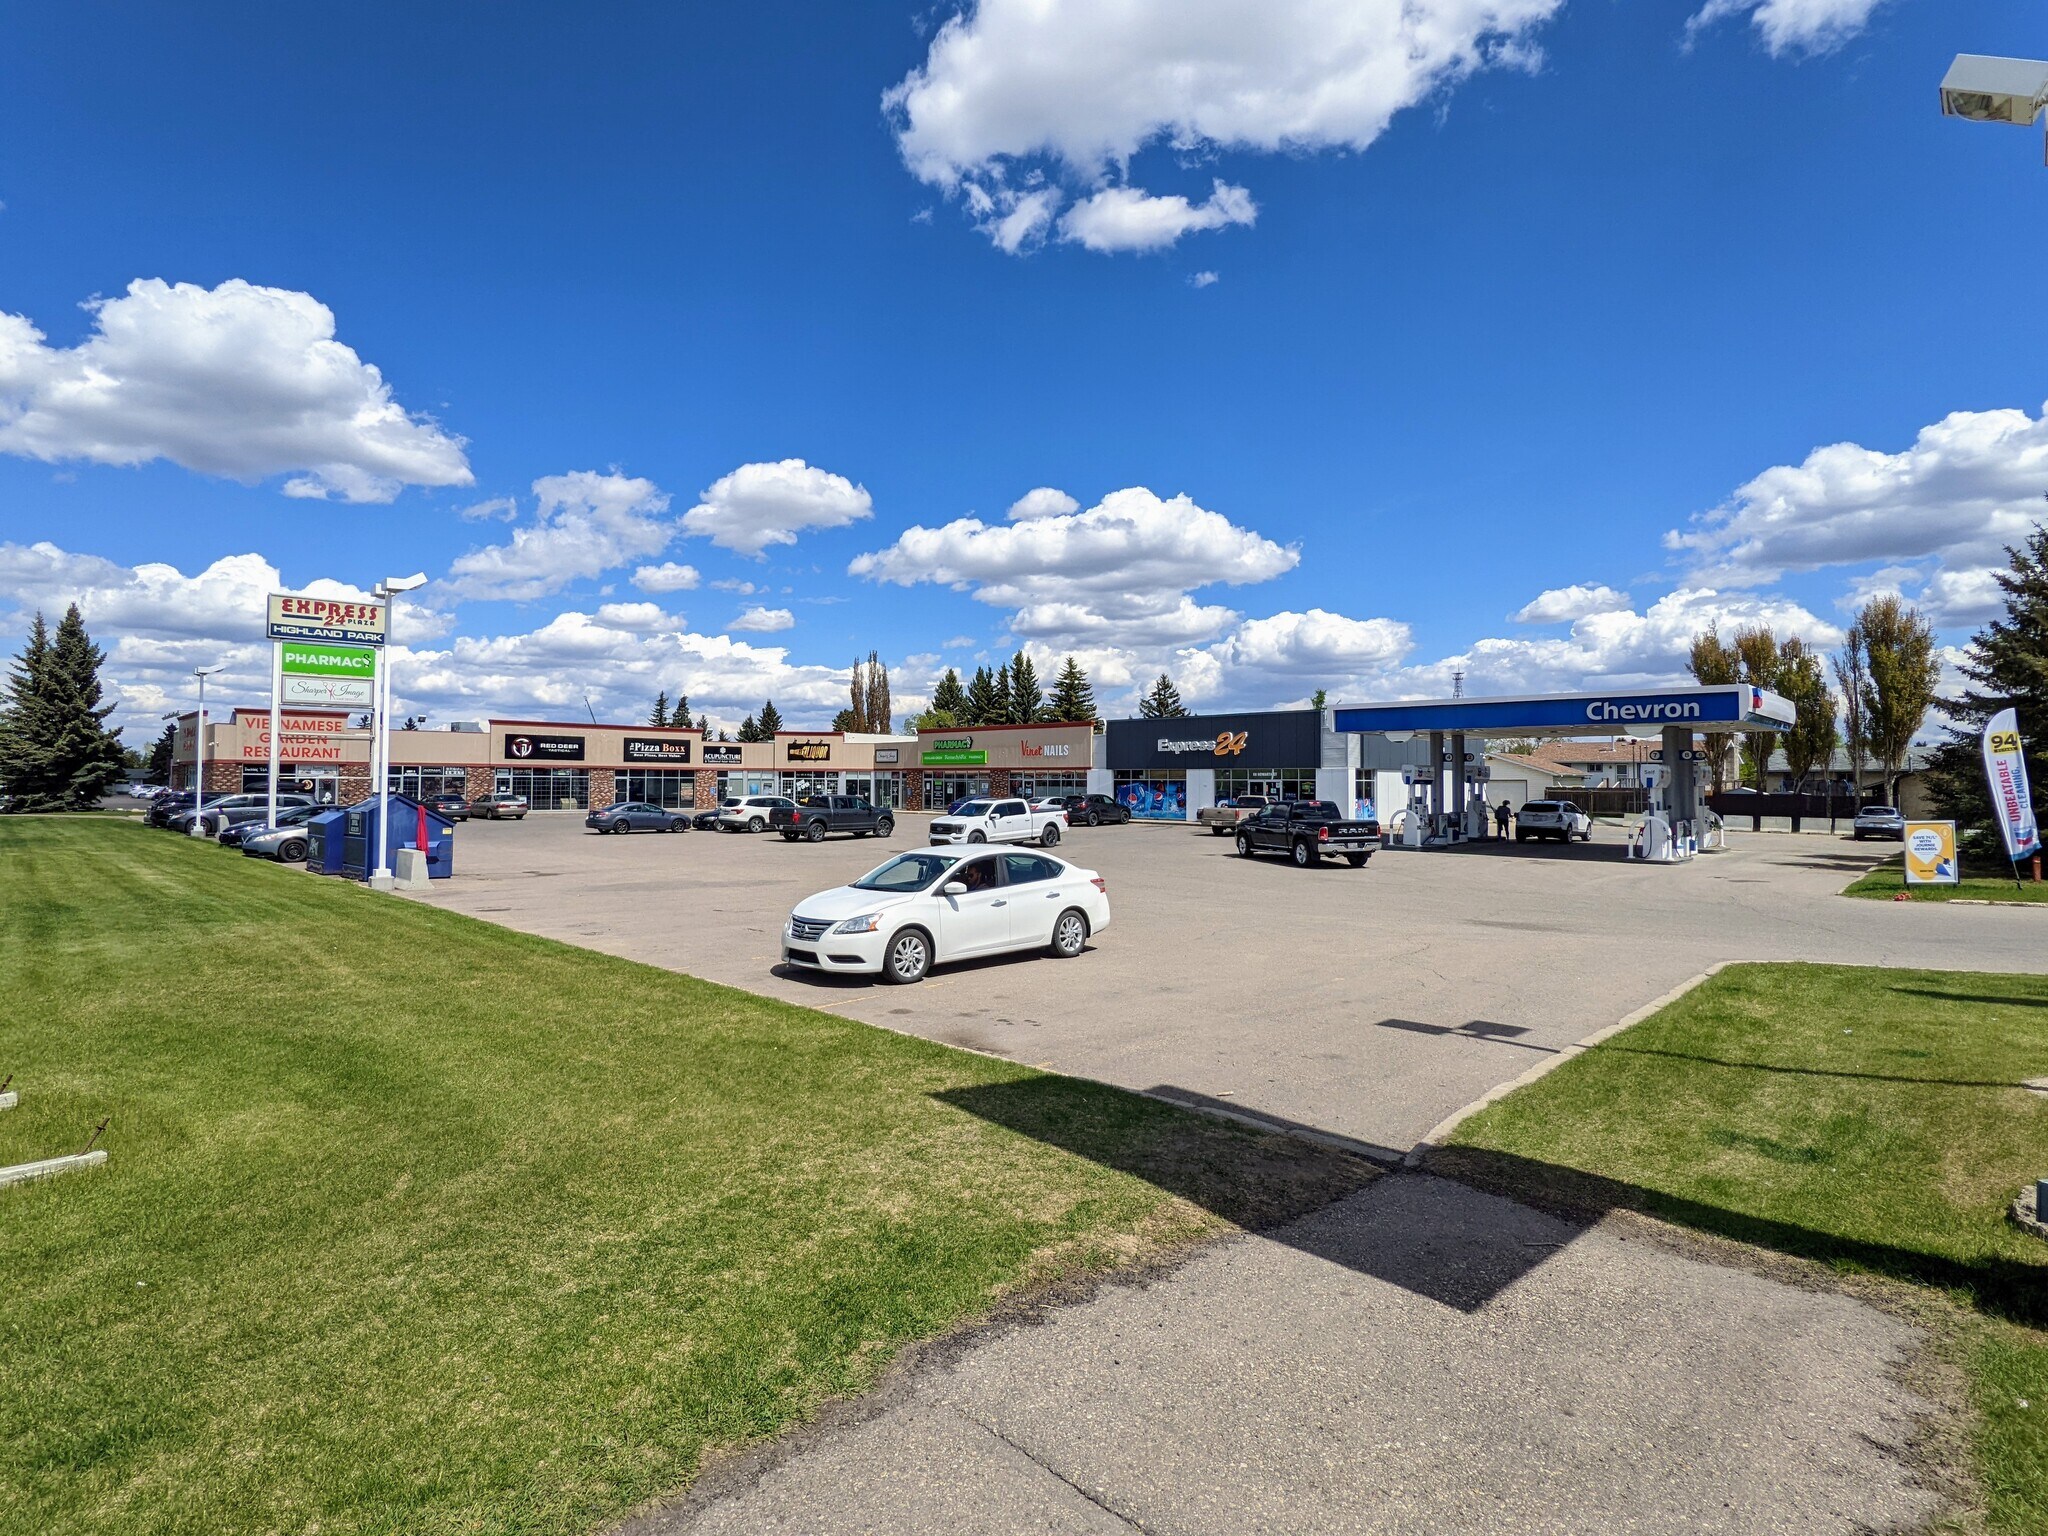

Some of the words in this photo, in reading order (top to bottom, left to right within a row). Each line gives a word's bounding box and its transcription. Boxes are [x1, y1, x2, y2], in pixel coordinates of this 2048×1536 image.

[282, 599, 377, 620] EXPRESS
[323, 615, 346, 626] 24
[273, 626, 343, 638] HIGHLAND
[347, 632, 382, 641] PARK
[1586, 701, 1700, 720] Chevron
[245, 717, 342, 731] VIENAMESE
[634, 743, 660, 752] Pizza
[662, 743, 685, 752] Boxx
[1158, 739, 1216, 754] Express
[1214, 732, 1248, 755] 24
[1991, 734, 2017, 749] 94
[243, 746, 341, 758] RESAURANT
[1044, 744, 1069, 756] NAILS
[1997, 760, 2021, 822] UNBEATABLE
[2011, 766, 2028, 809] CLEANING.
